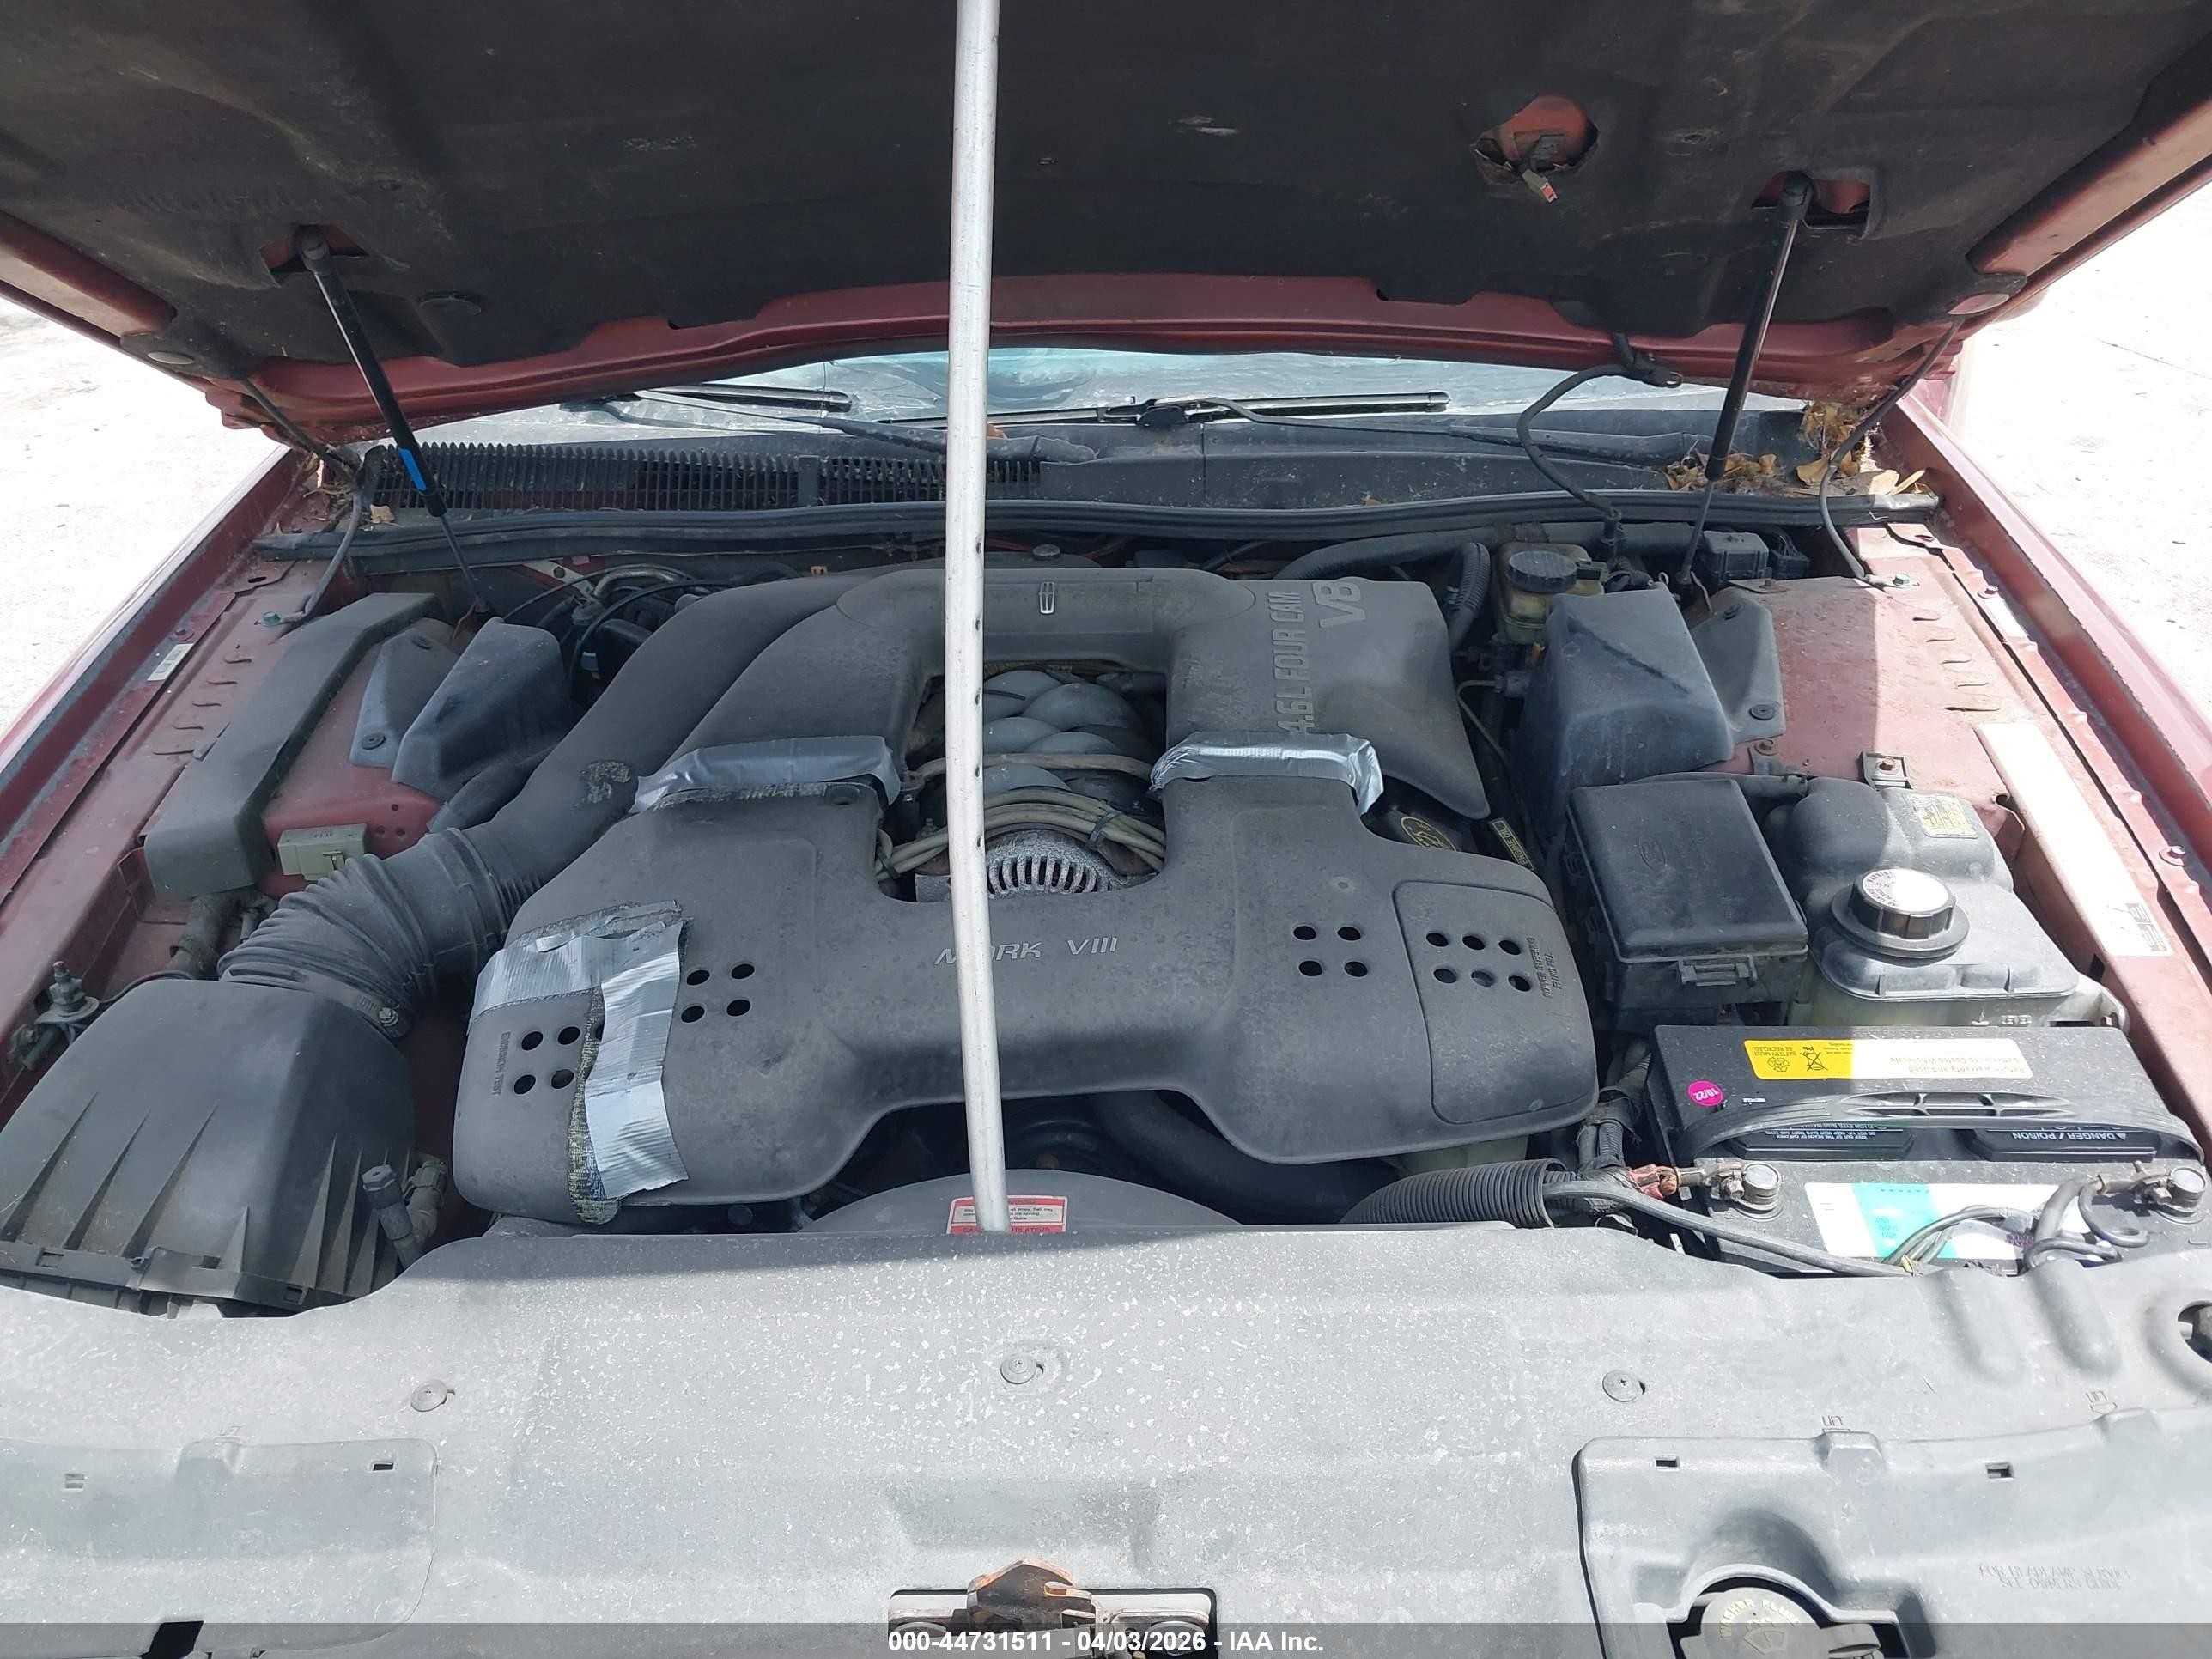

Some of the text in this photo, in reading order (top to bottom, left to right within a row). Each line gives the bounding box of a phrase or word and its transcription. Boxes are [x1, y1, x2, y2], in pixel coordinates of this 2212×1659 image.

[1312, 581, 1366, 628] V8
[1267, 592, 1316, 734] 4.6L FOUR CAM
[934, 937, 1118, 965] MRK VIII
[1692, 1088, 1719, 1100] 10/22
[2012, 1132, 2057, 1140] POISON
[2066, 1132, 2117, 1140] DANGER
[1719, 1599, 1800, 1638] WASHER FLUID
